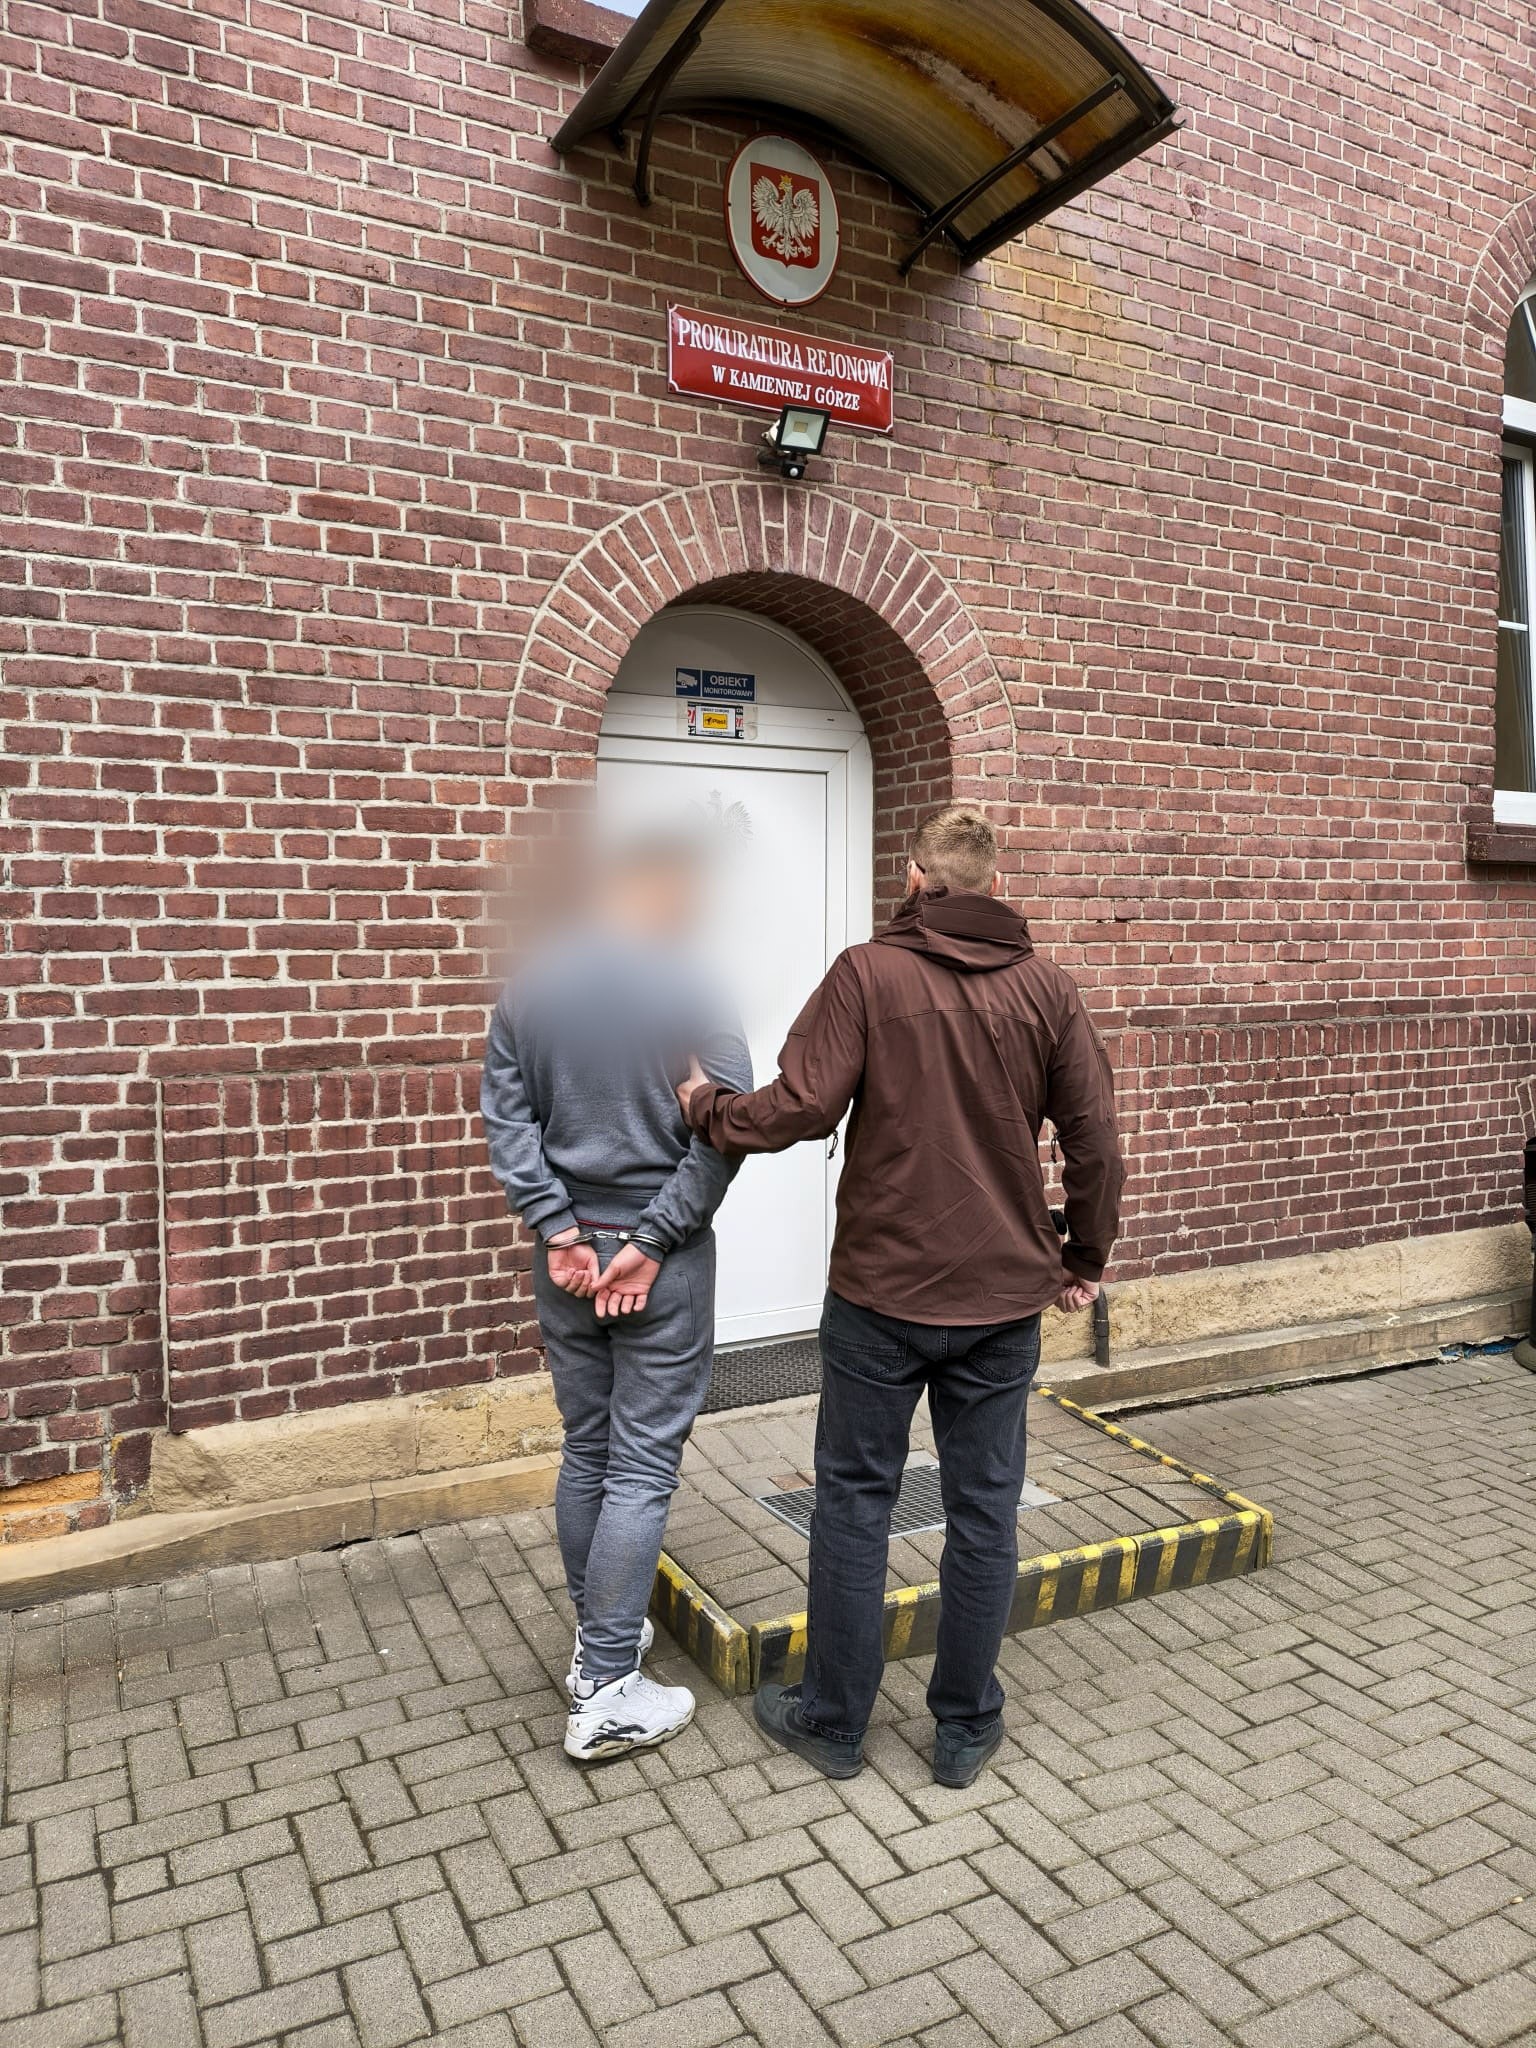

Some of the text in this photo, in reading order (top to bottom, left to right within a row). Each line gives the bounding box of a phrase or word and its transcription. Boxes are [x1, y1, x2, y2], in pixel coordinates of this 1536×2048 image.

[678, 318, 889, 390] PROKURATURA REJONOWA
[712, 365, 860, 411] W KAMIENNEJ GÓRZE
[703, 687, 753, 697] MONITOROWANY
[709, 675, 748, 687] OBIEKT
